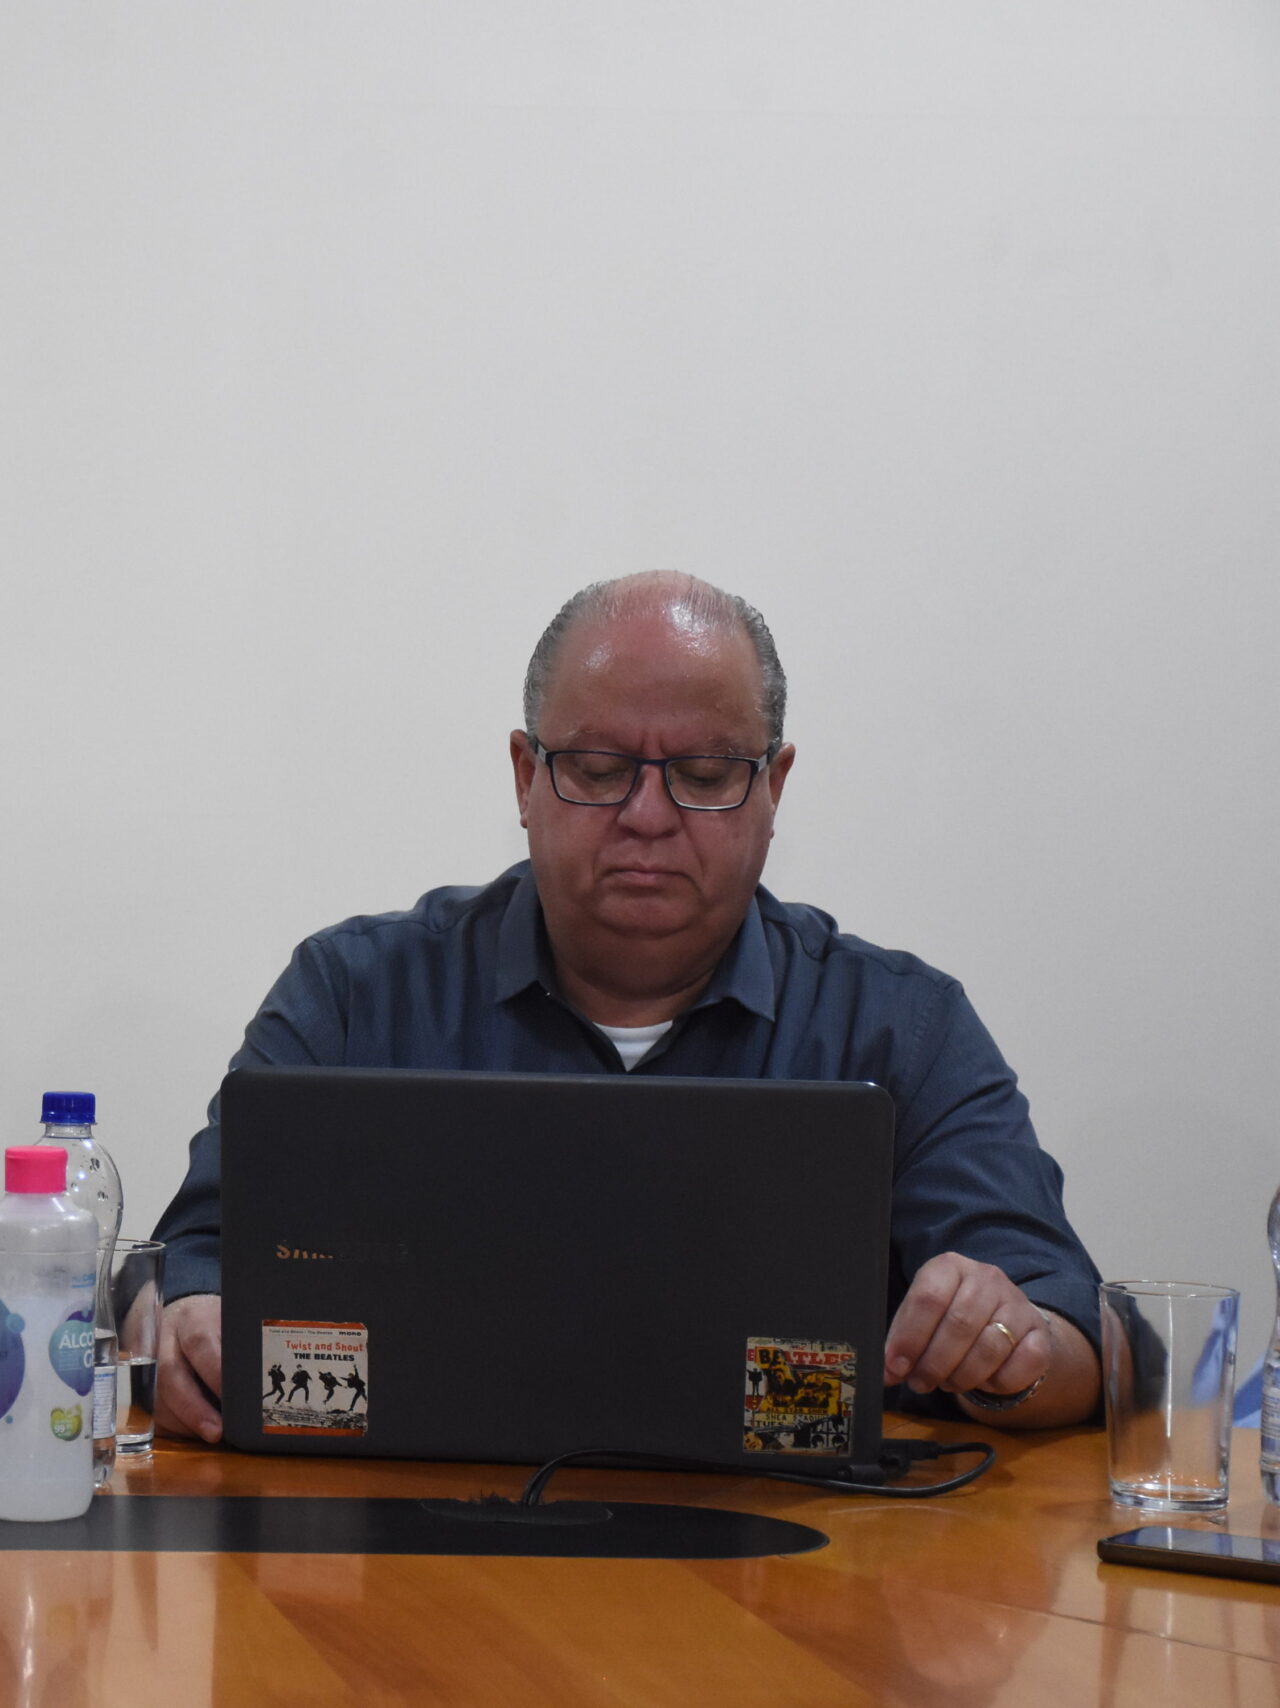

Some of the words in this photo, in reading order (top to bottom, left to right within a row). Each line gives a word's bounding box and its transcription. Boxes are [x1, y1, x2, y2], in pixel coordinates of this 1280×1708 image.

[286, 1340, 312, 1351] Twist
[314, 1342, 333, 1351] and
[335, 1342, 364, 1352] Shout
[293, 1352, 311, 1360] THE
[314, 1353, 355, 1361] BEATLES
